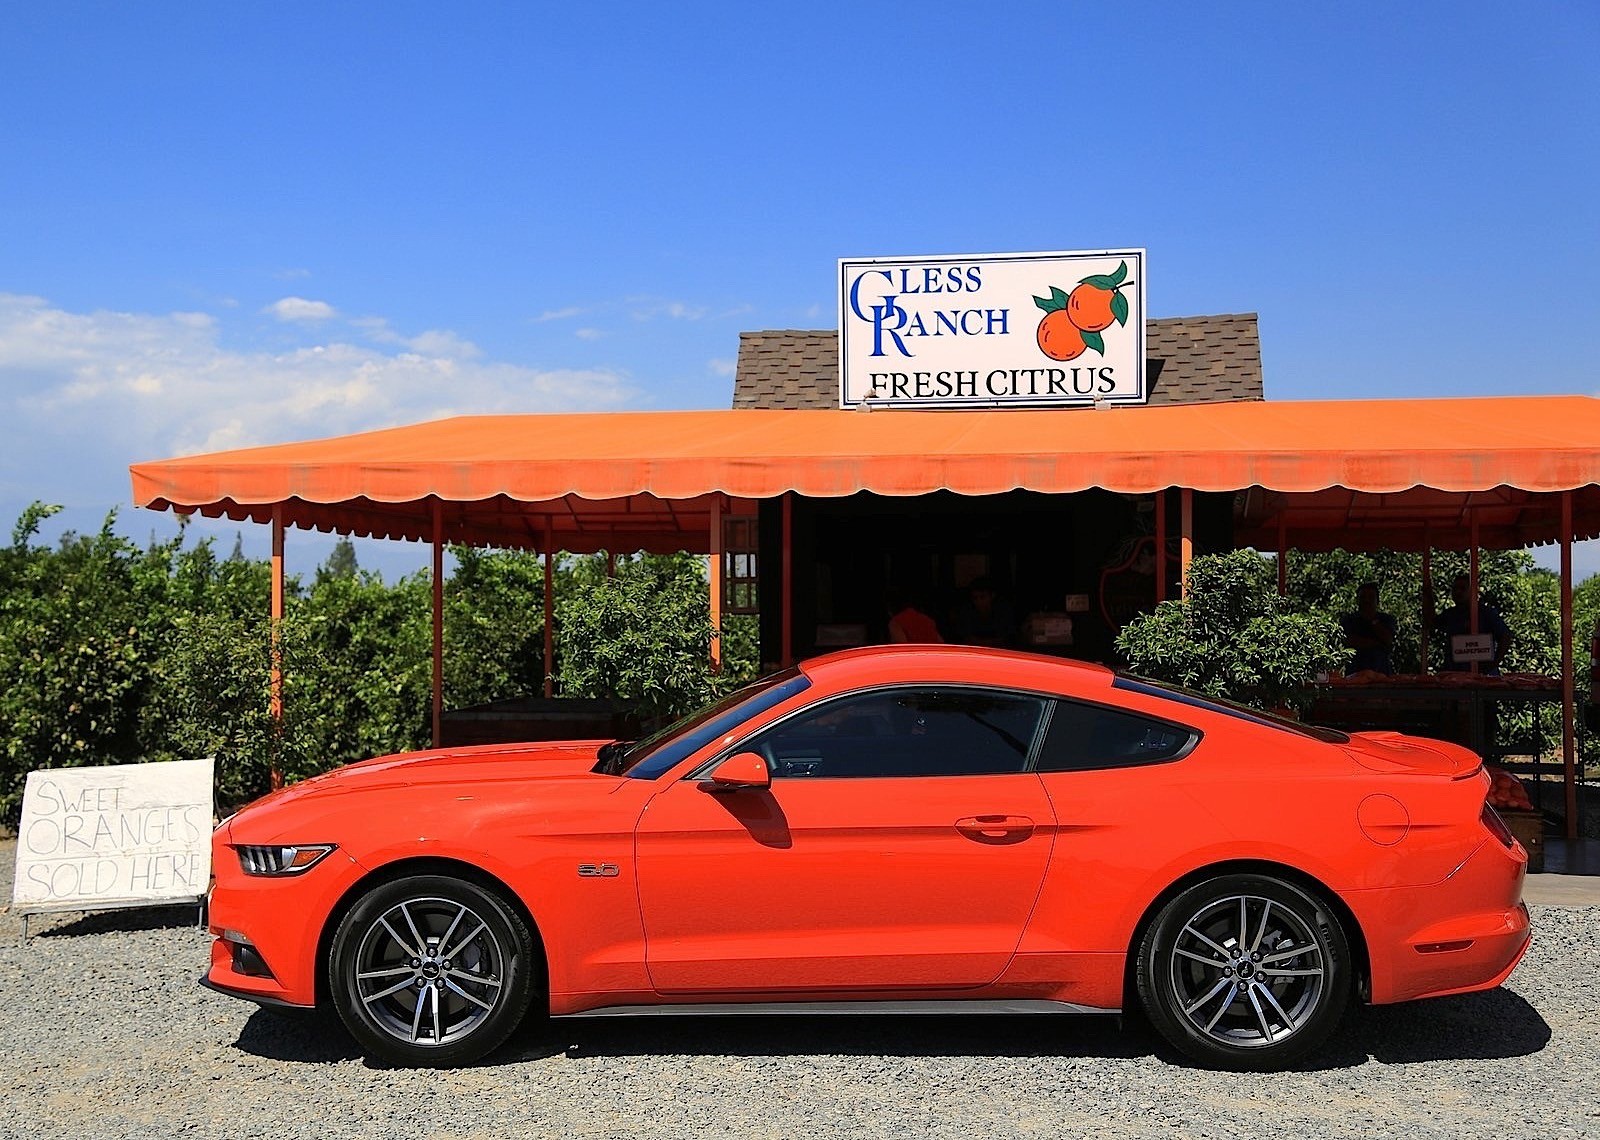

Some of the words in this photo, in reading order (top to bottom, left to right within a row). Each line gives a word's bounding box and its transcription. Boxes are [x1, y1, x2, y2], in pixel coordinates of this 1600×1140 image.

[849, 266, 982, 323] GLESS
[868, 304, 1011, 358] RANCH
[869, 371, 979, 399] FRESH
[985, 366, 1117, 395] CITRUS
[32, 780, 122, 816] SWEET
[26, 806, 200, 855] ORANGES
[27, 859, 119, 898] SOLD
[130, 854, 200, 891] HERE
